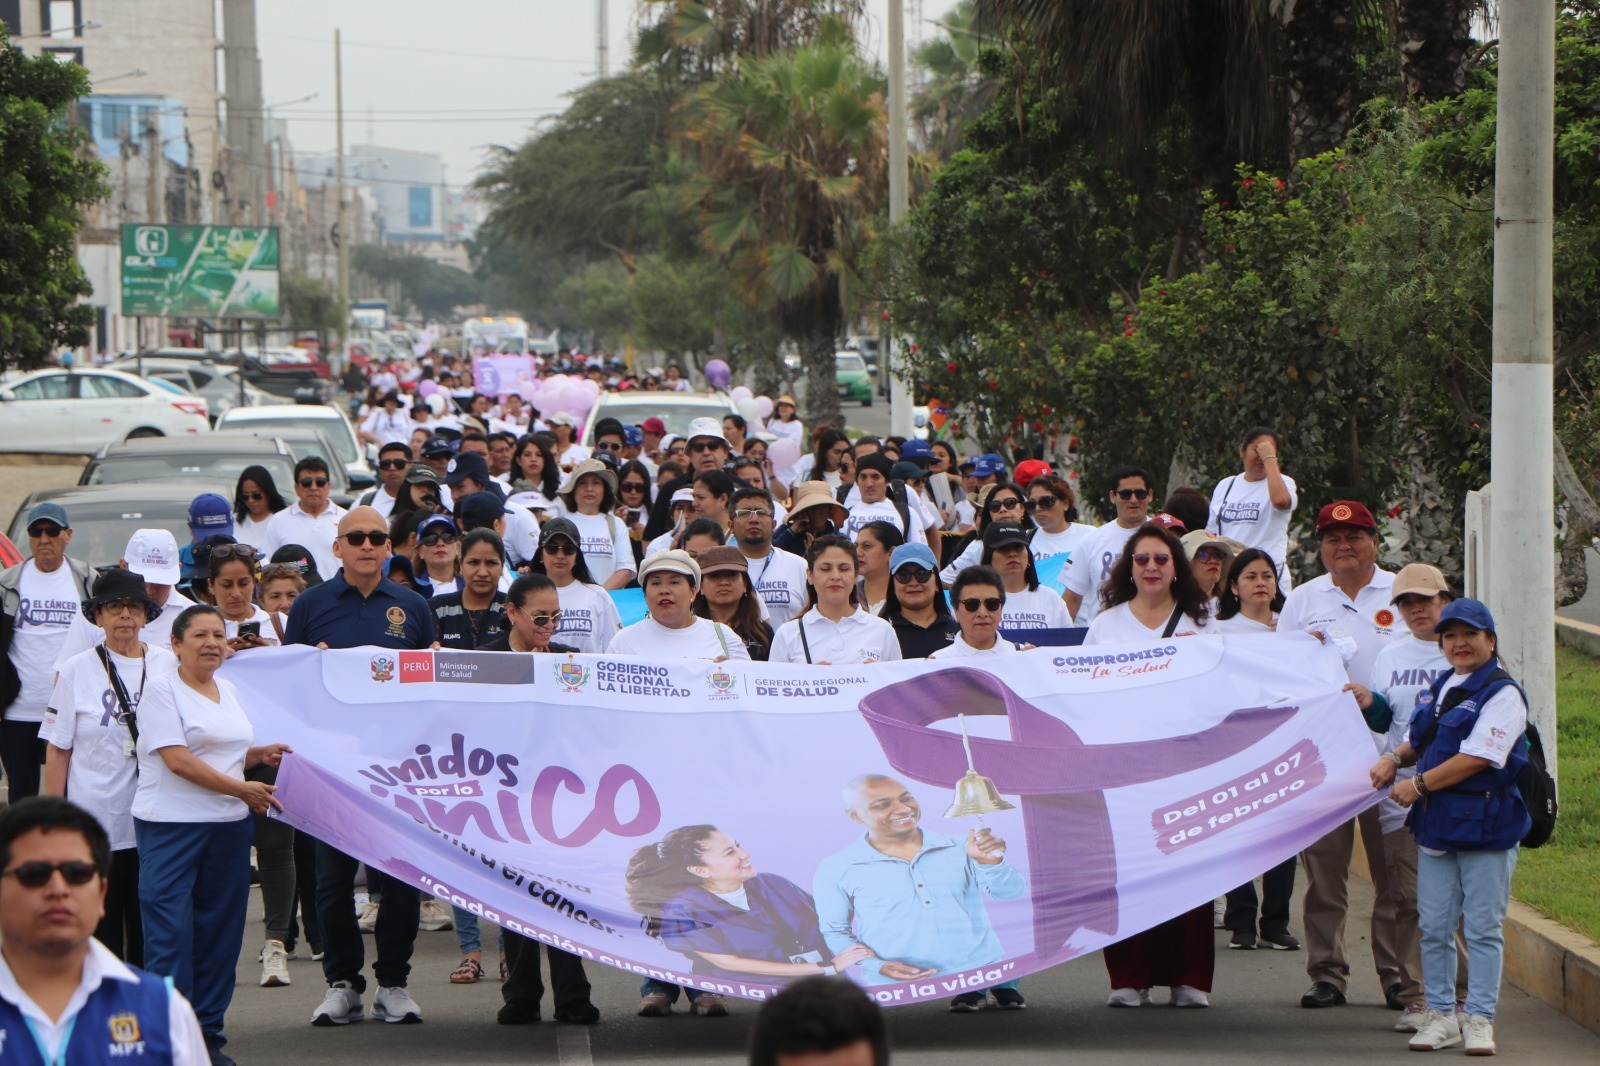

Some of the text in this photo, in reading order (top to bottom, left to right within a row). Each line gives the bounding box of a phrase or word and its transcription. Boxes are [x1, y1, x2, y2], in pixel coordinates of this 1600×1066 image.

[1225, 511, 1258, 520] NO AVISA
[590, 545, 613, 553] AVISA
[760, 580, 788, 590] ÁNCER
[33, 599, 77, 610] EL CÁNCER
[32, 611, 46, 621] NO
[1015, 611, 1046, 622] CÁNCER
[563, 619, 592, 631] AVISA
[1003, 622, 1048, 630] NO AVISA
[867, 651, 880, 661] UCT
[1052, 645, 1178, 667] COMPROMISO
[403, 660, 430, 672] PERÚ
[439, 662, 478, 671] Ministerio
[596, 661, 669, 677] GOBIERNO
[1090, 665, 1112, 680] La
[1116, 658, 1173, 678] Salud
[440, 670, 449, 678] de
[597, 671, 675, 687] REGIONAL
[755, 677, 869, 687] GERENCIA REGIONAL
[597, 681, 691, 697] LA LIBERTAD
[756, 686, 839, 697] DE SALUD
[415, 783, 475, 796] por lo
[1163, 751, 1302, 825] Del 01 al 07
[1169, 779, 1306, 845] de febrero
[506, 919, 594, 959] acción
[599, 954, 695, 987] cuenta
[700, 981, 735, 994] en
[739, 984, 766, 999] la
[909, 983, 937, 999] la
[108, 1040, 146, 1057] MPT
